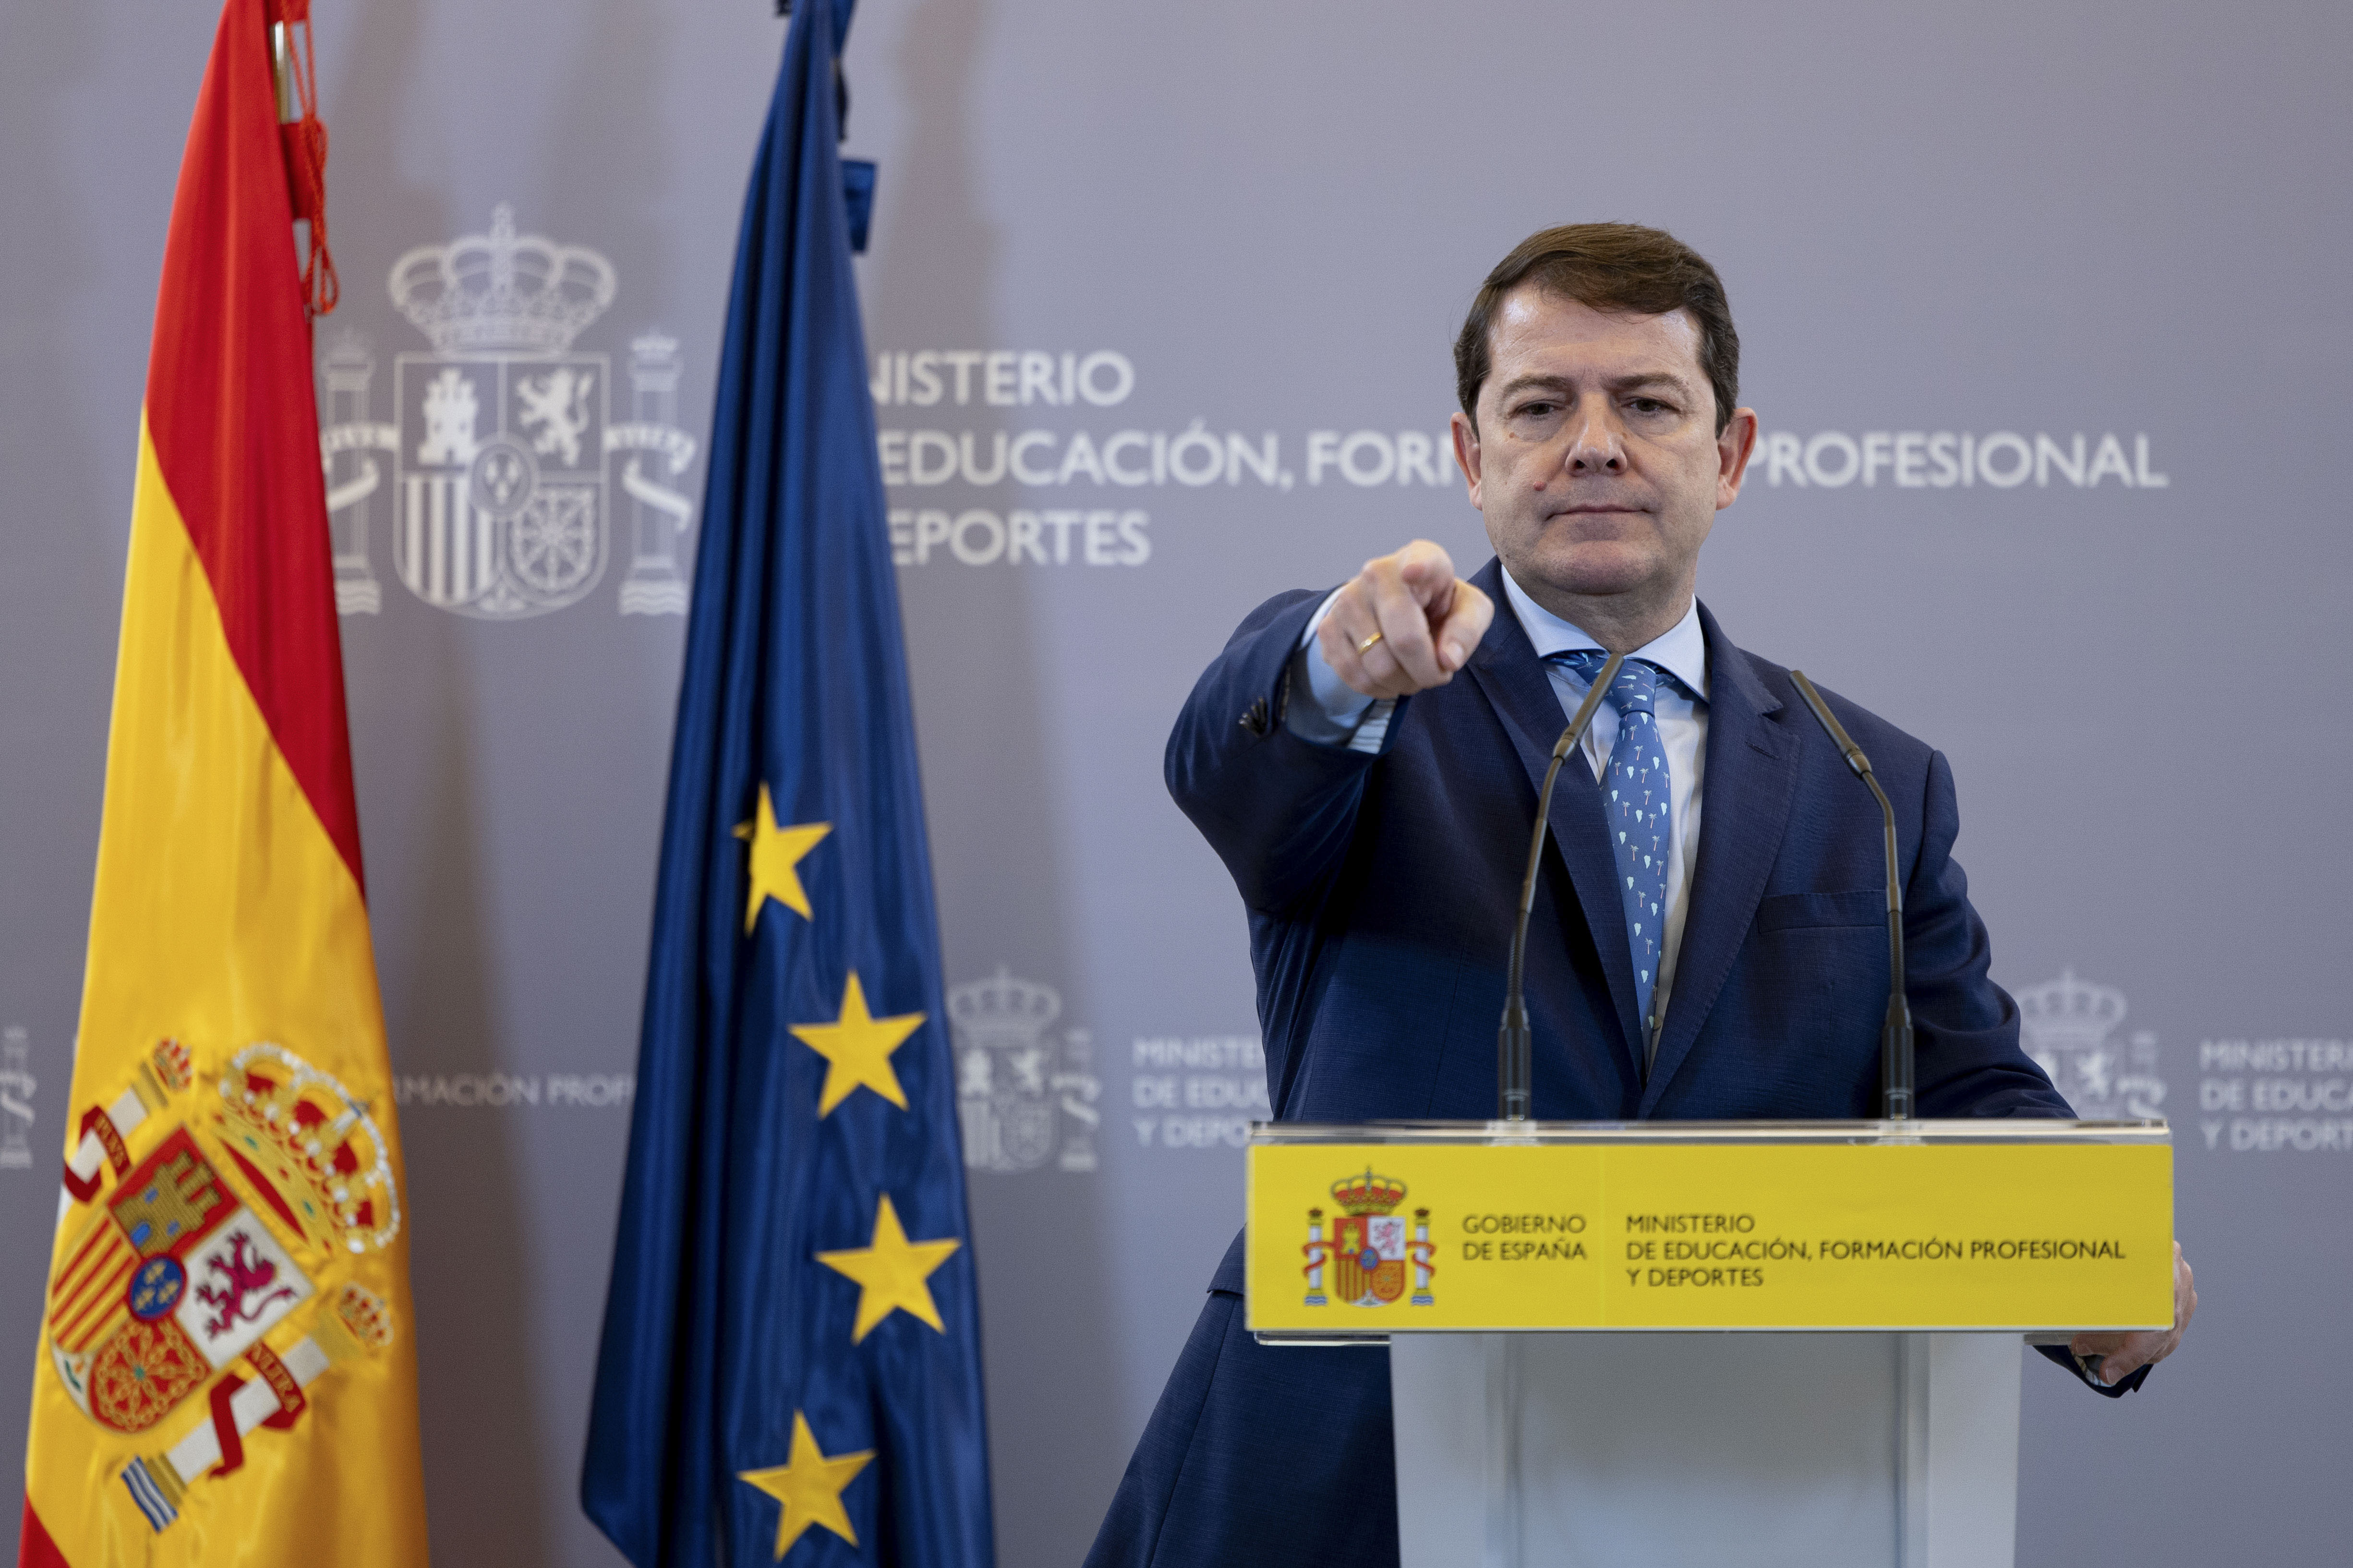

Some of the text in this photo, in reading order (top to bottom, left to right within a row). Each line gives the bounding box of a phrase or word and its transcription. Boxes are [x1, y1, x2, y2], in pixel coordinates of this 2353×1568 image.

[1308, 432, 1454, 486] FOR
[1133, 1077, 1178, 1107] DE
[2200, 1080, 2244, 1110] DE
[1133, 1117, 1157, 1146] Y
[2200, 1118, 2223, 1150] Y
[1462, 1214, 1586, 1234] GOBIERNO
[1627, 1214, 1755, 1233] MINISTERIO
[1462, 1237, 1587, 1260] DE ESPAÑA
[1627, 1236, 2126, 1263] DE EDUCACIÓN, FORMACIÓN PROFESIONAL
[1627, 1268, 1763, 1287] Y DEPORTES
